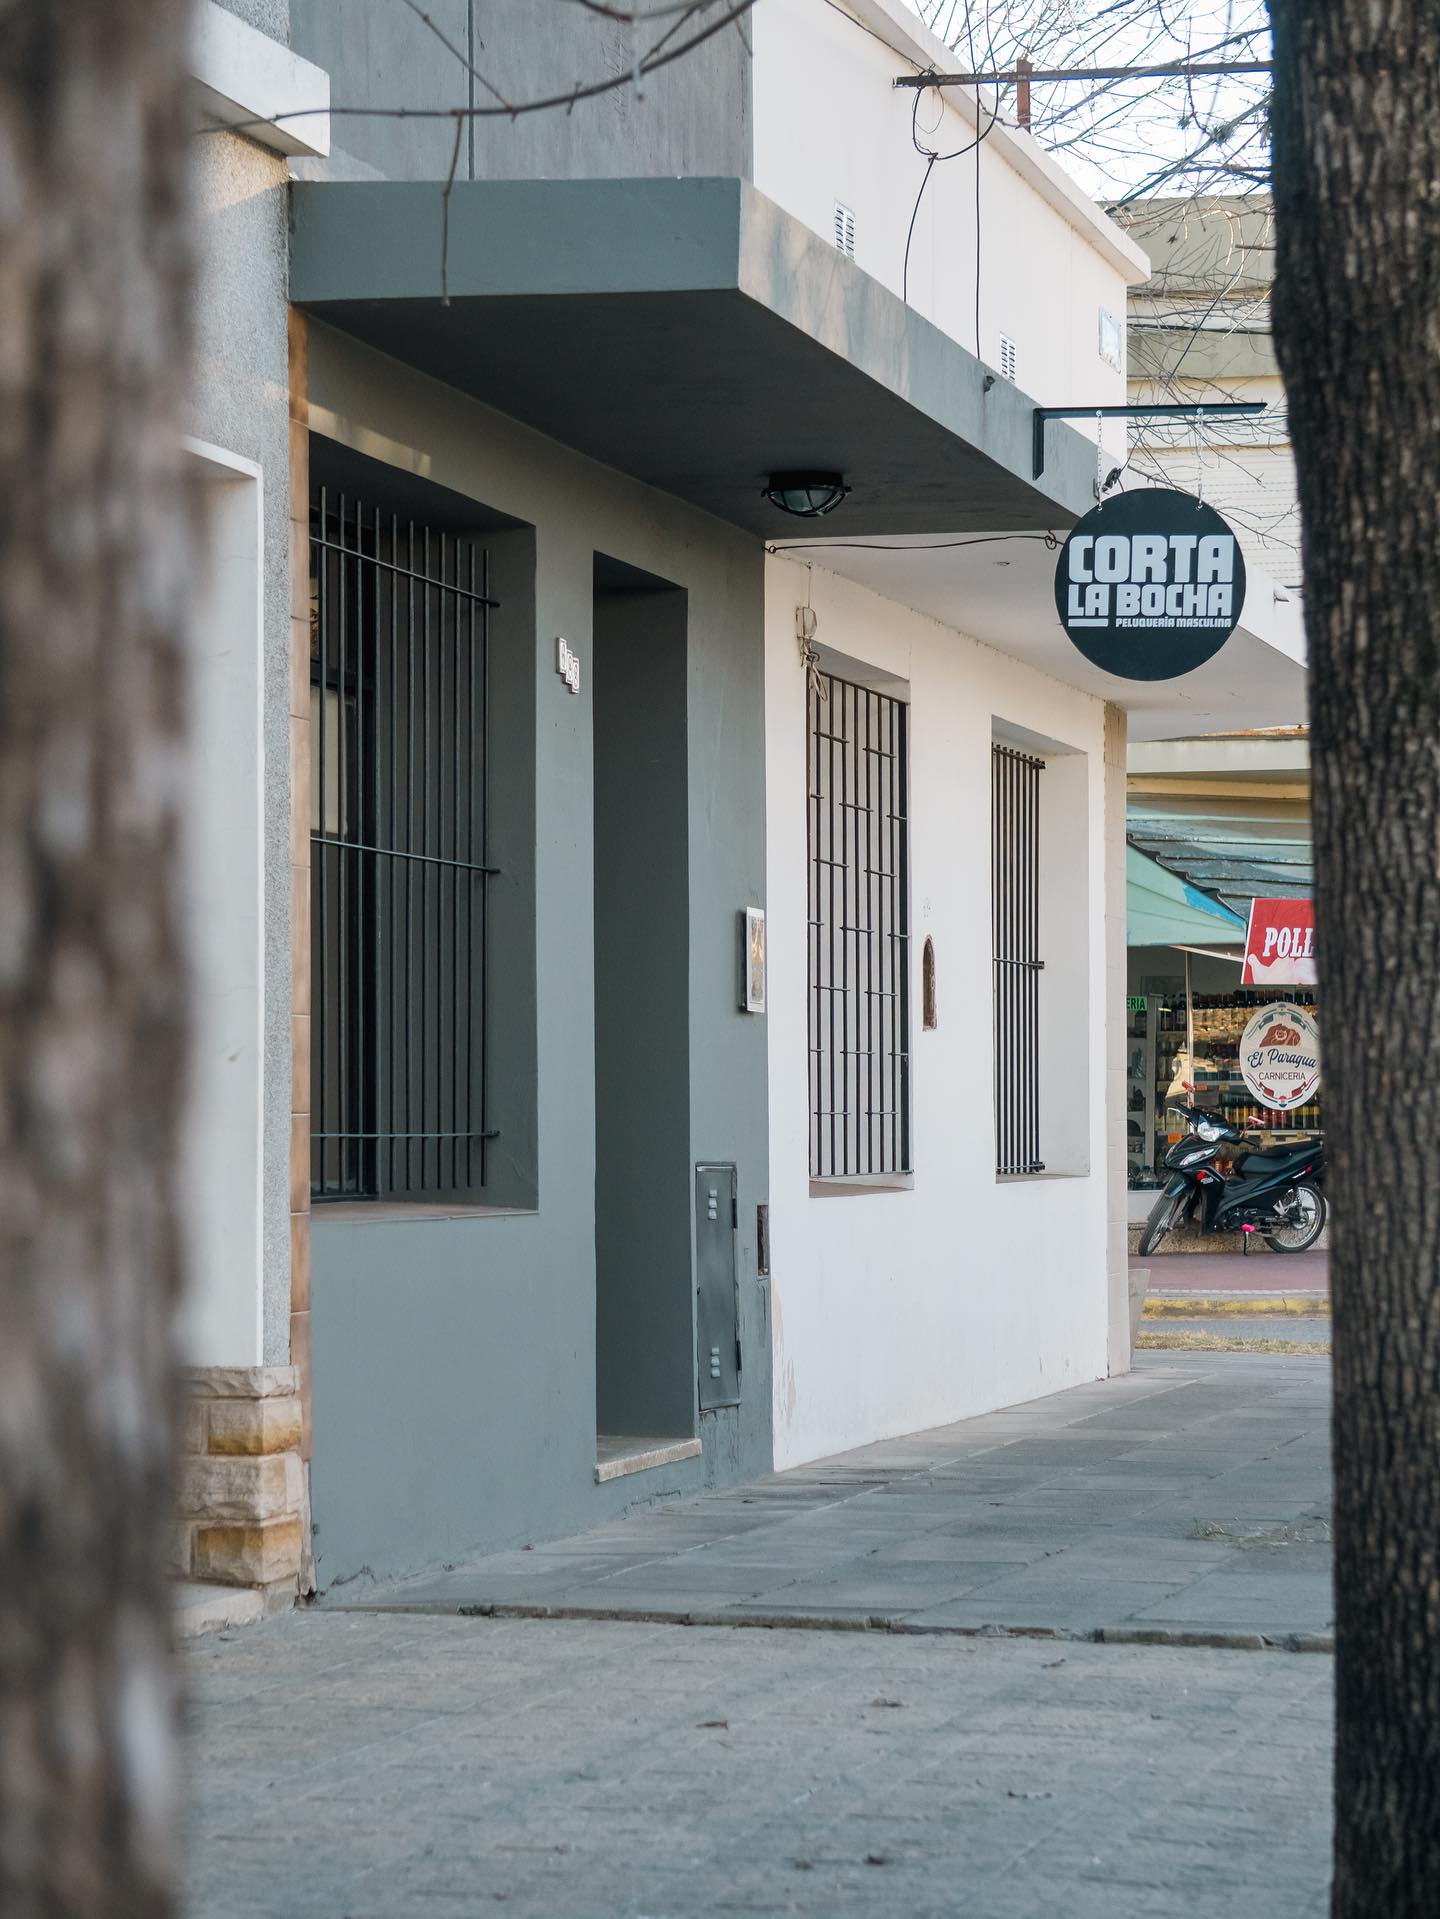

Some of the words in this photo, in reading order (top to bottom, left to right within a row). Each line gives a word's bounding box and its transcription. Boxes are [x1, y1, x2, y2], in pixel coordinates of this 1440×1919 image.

[1069, 535, 1234, 583] CORTA
[1068, 584, 1109, 616] LA
[1116, 584, 1232, 616] BOCHA
[1116, 617, 1175, 628] PELUQUERÍA
[1176, 618, 1232, 628] MASCULINA
[1247, 1051, 1264, 1068] El
[1267, 1048, 1317, 1068] Paragua
[1258, 1072, 1306, 1080] CARNICERIA
